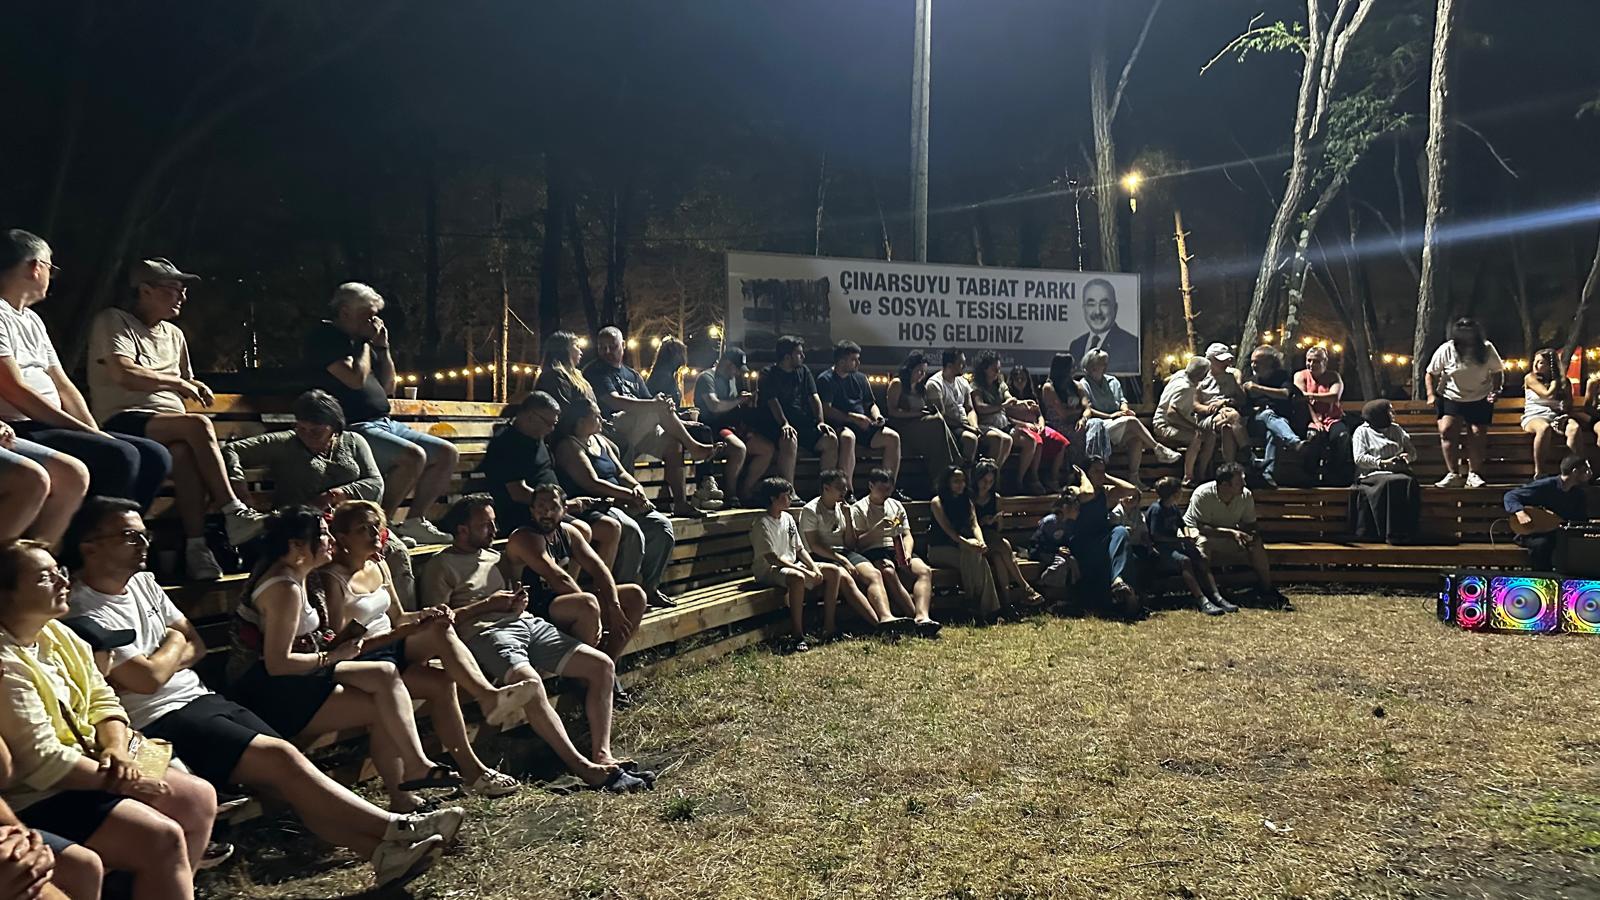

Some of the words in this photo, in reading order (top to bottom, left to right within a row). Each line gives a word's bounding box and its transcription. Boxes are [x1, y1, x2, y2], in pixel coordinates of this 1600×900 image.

[840, 270, 950, 295] ÇINARSUYU
[1024, 280, 1076, 299] PARKI
[849, 299, 872, 315] ve
[878, 297, 950, 318] SOSYAL
[898, 322, 937, 346] HOŞ
